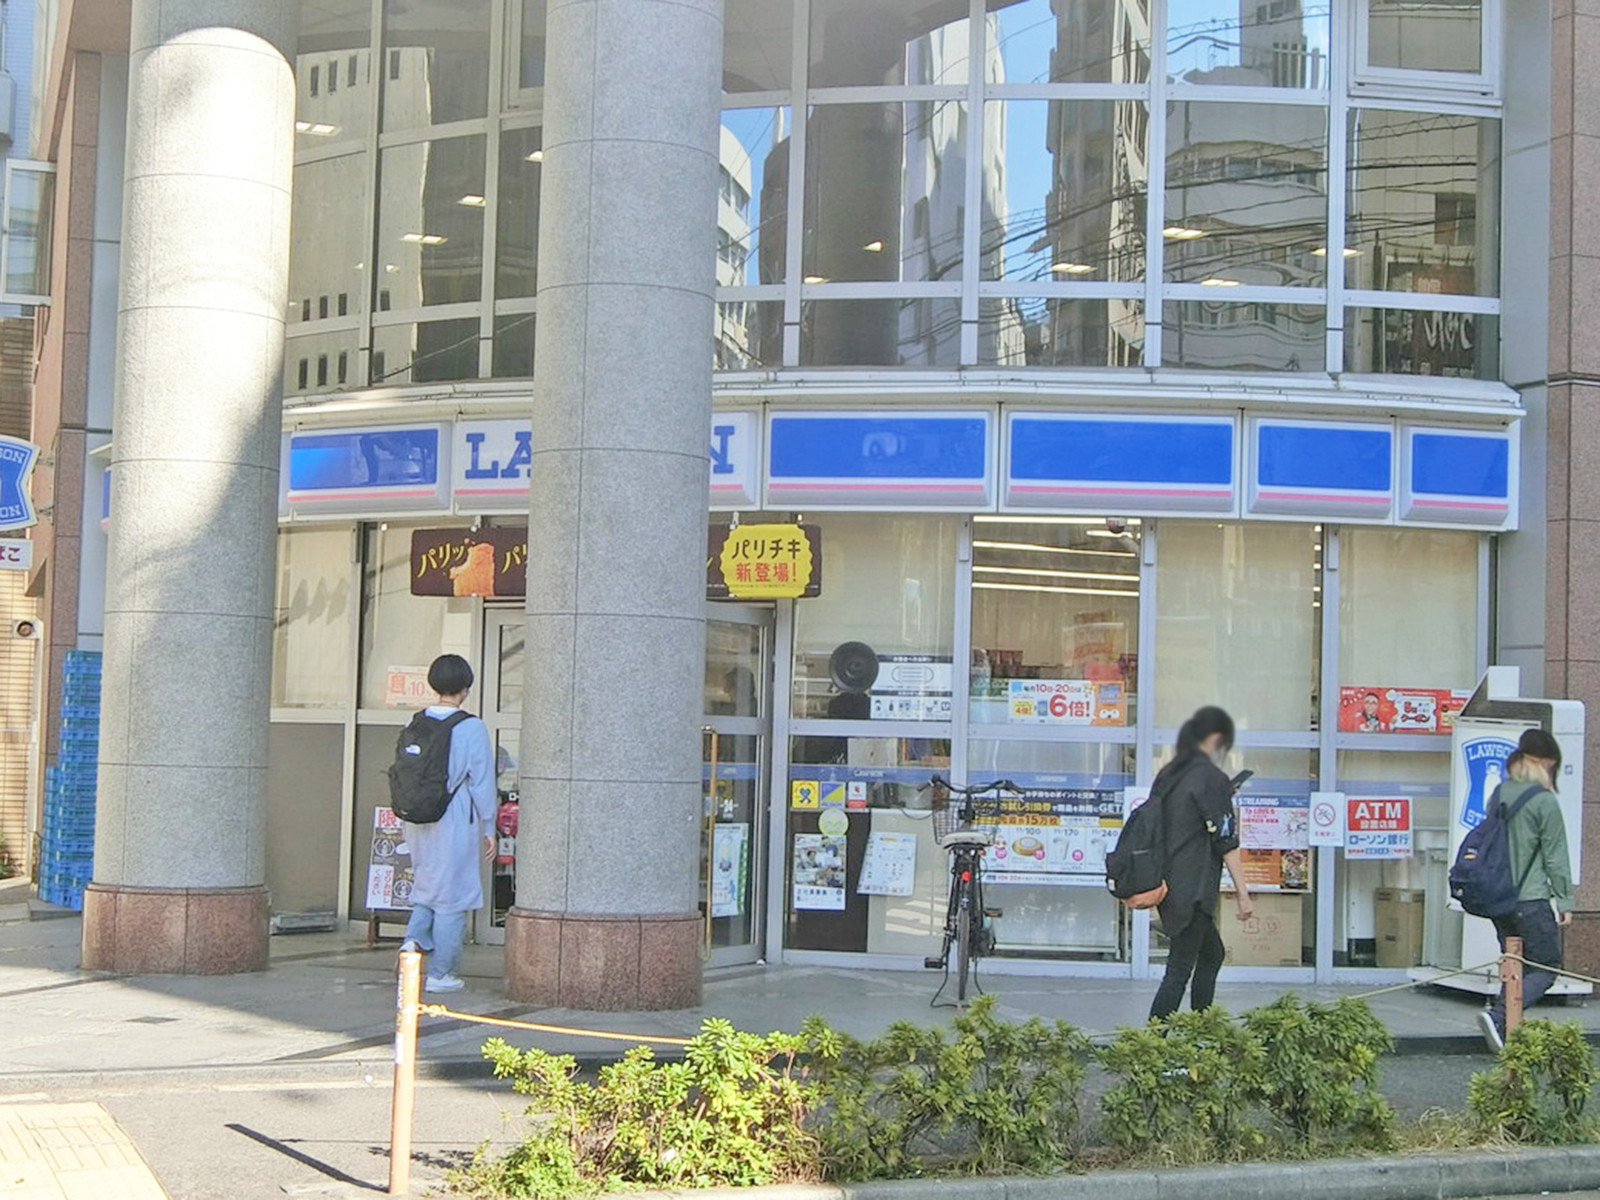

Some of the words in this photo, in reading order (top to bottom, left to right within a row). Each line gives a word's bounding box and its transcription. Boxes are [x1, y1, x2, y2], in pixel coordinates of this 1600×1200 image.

[731, 539, 800, 559] パリチキ
[417, 542, 465, 578] パリッ
[736, 563, 797, 582] 新登場!
[1049, 694, 1090, 717] 6倍!
[1354, 803, 1401, 819] ATM
[1348, 834, 1409, 845] ローソン銀行
